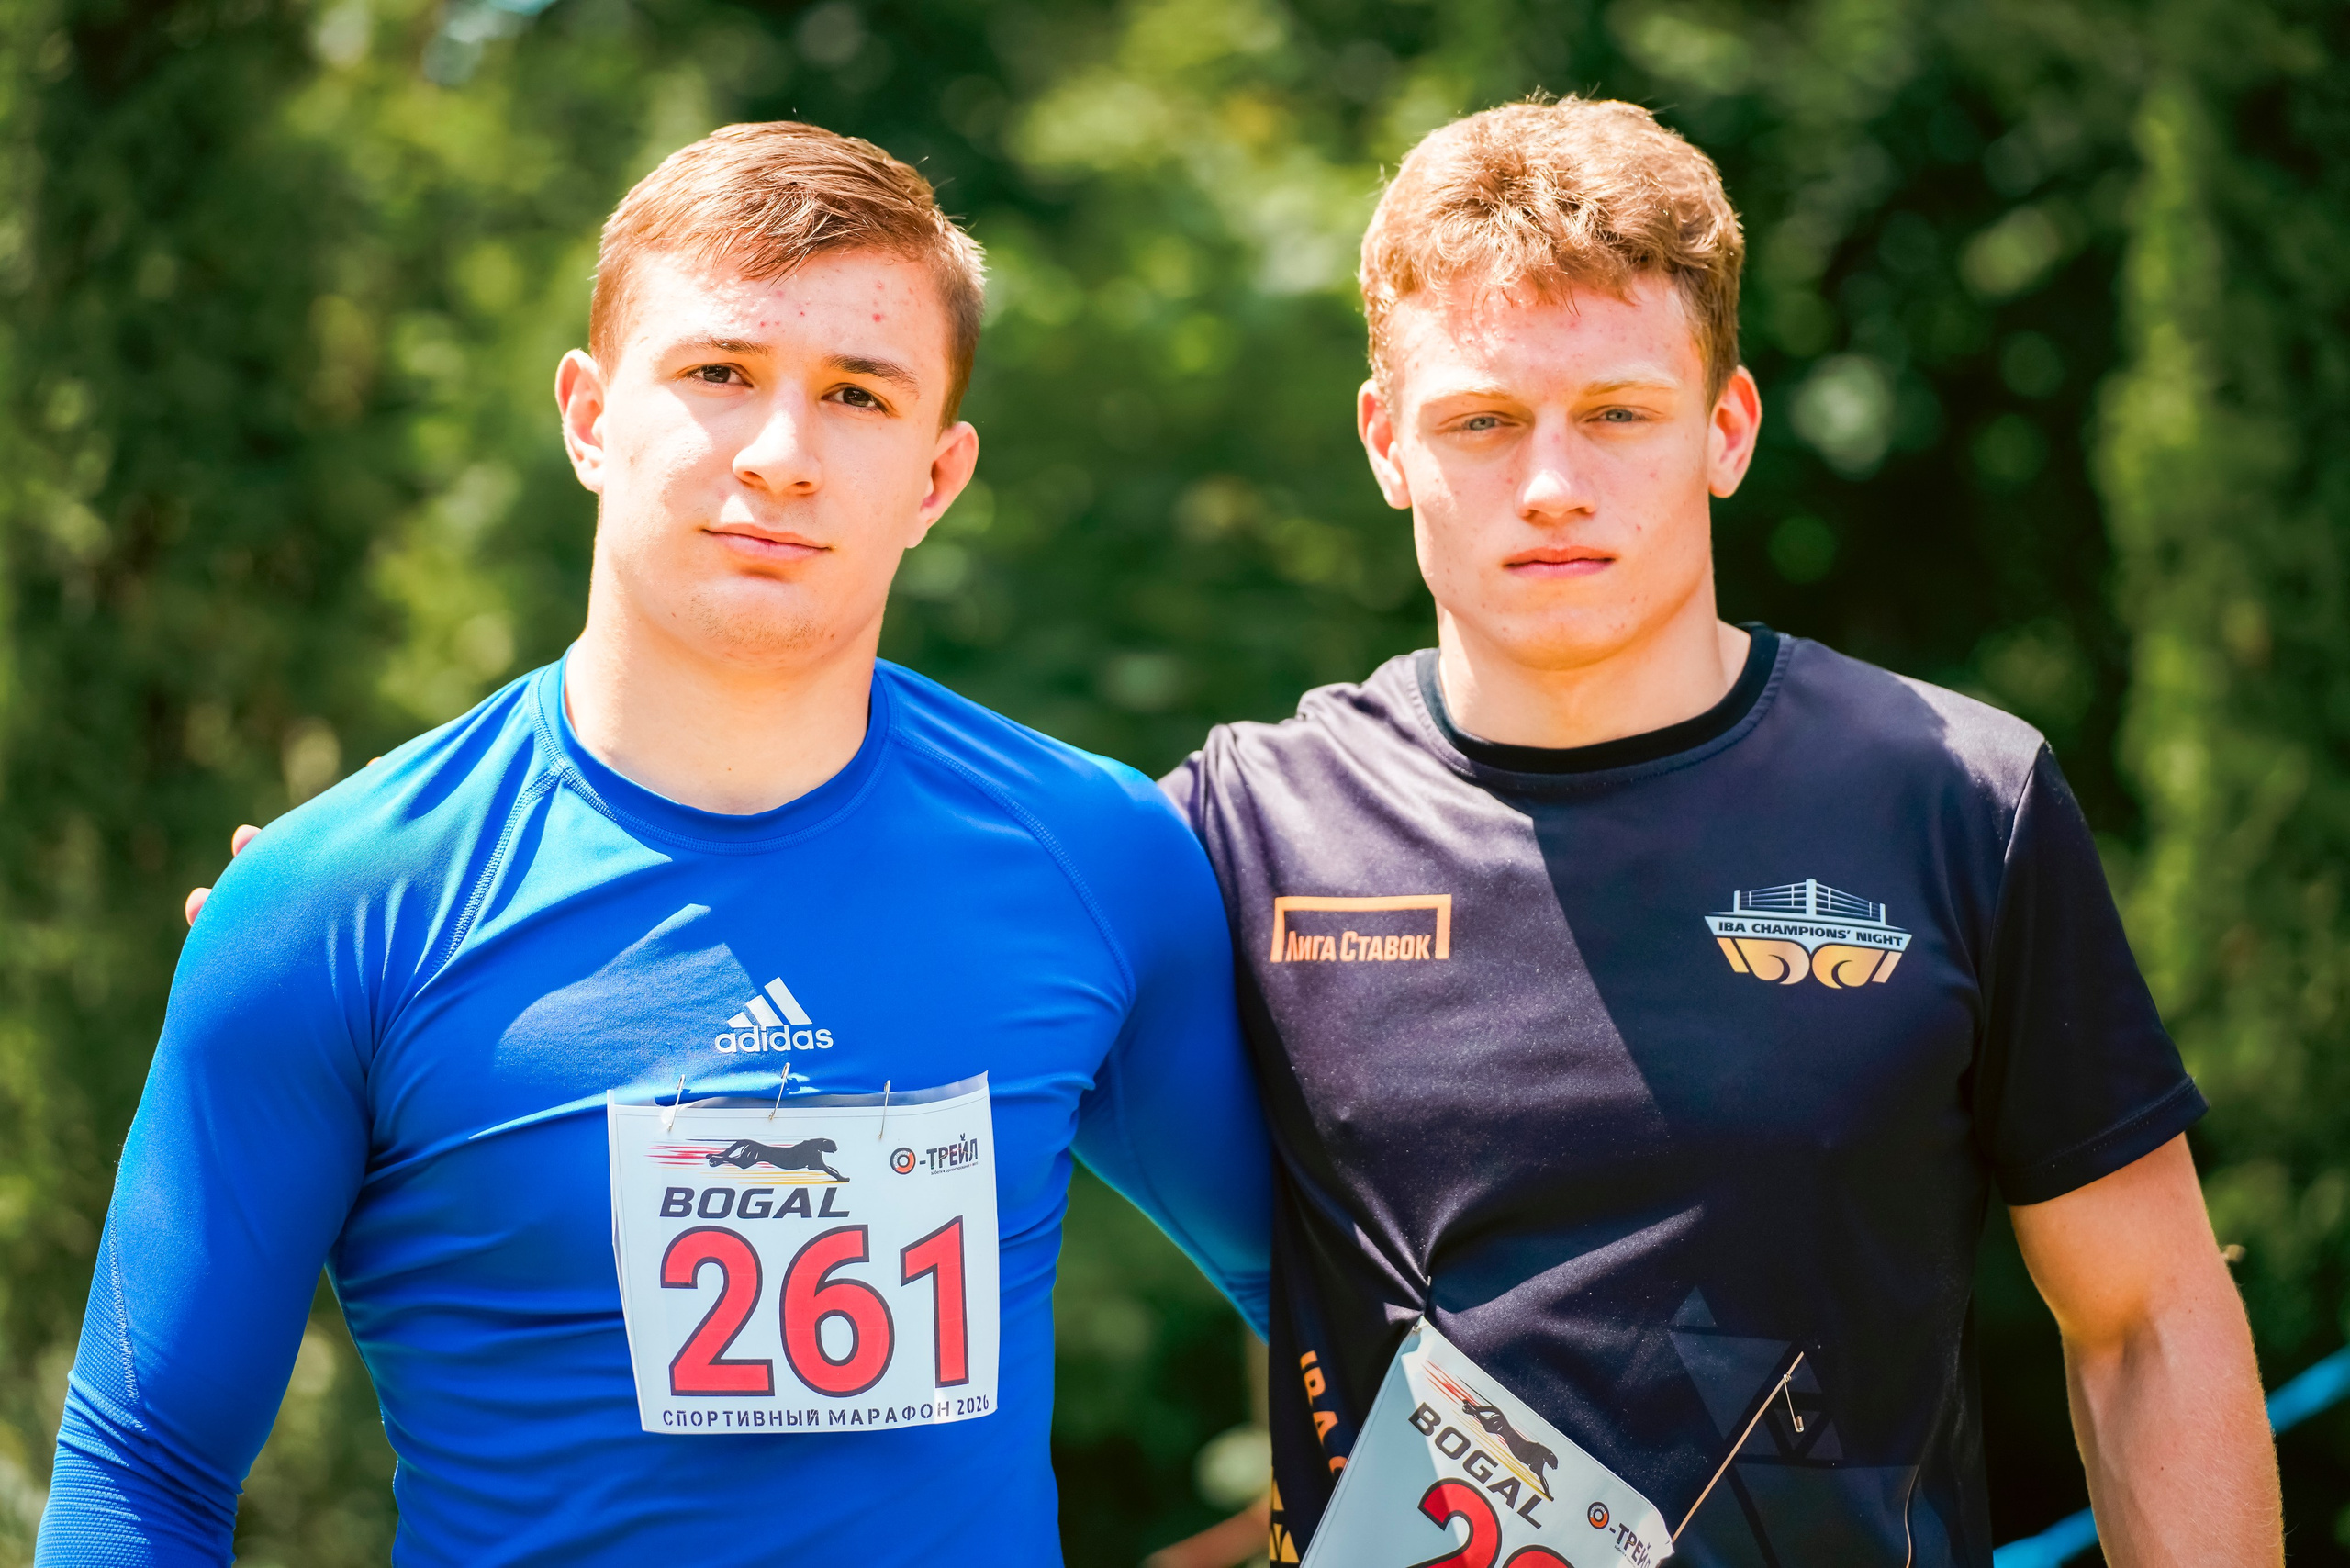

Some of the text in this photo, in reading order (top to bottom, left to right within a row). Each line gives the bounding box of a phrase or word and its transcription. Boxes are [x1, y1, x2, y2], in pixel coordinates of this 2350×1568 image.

[1718, 921, 1746, 933] IBA
[1856, 932, 1903, 946] NIGHT
[714, 1024, 834, 1054] adidas
[659, 1186, 850, 1219] BOGAL
[660, 1215, 970, 1398] 261
[662, 1394, 990, 1427] СПОРТИВНЫЙ МАРАФОН 2026
[1408, 1402, 1543, 1530] BOGAL
